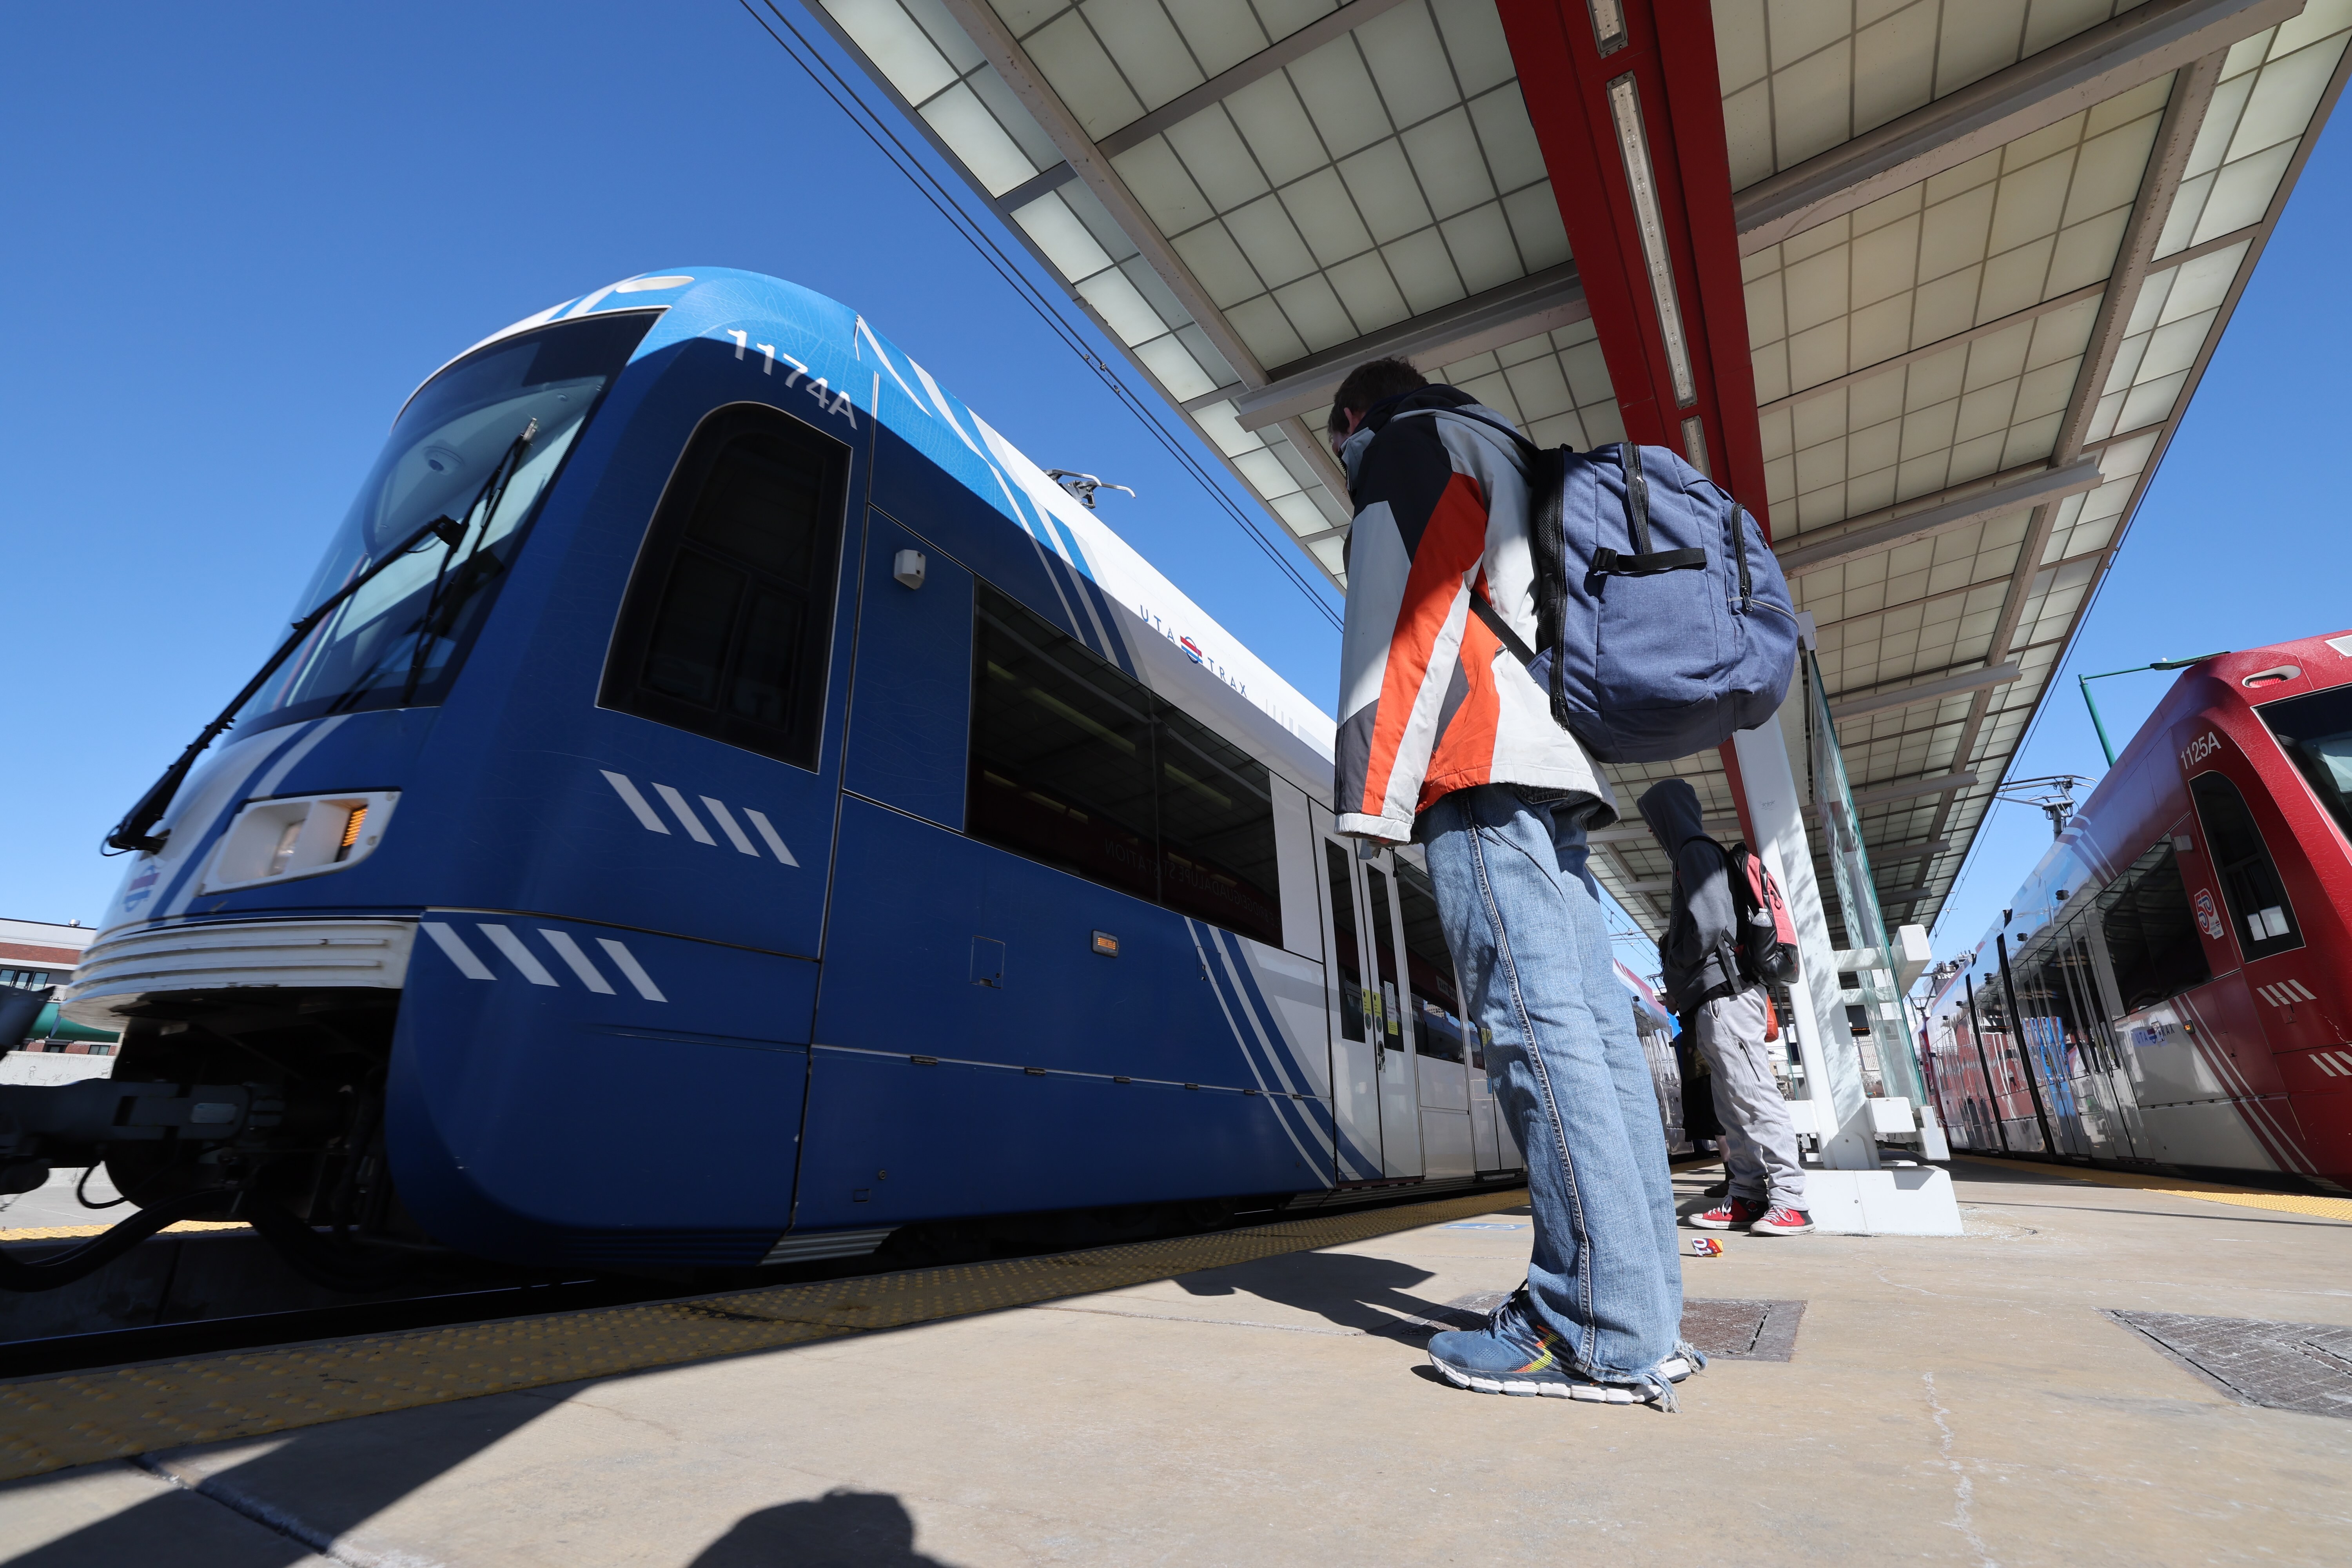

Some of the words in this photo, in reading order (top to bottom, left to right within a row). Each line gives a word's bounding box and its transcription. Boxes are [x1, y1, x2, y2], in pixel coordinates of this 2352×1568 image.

[727, 328, 857, 430] 1174A
[1140, 604, 1175, 643] UTA
[1207, 656, 1247, 698] TRAX
[2181, 731, 2221, 769] 1125A
[2135, 1031, 2149, 1044] UTA
